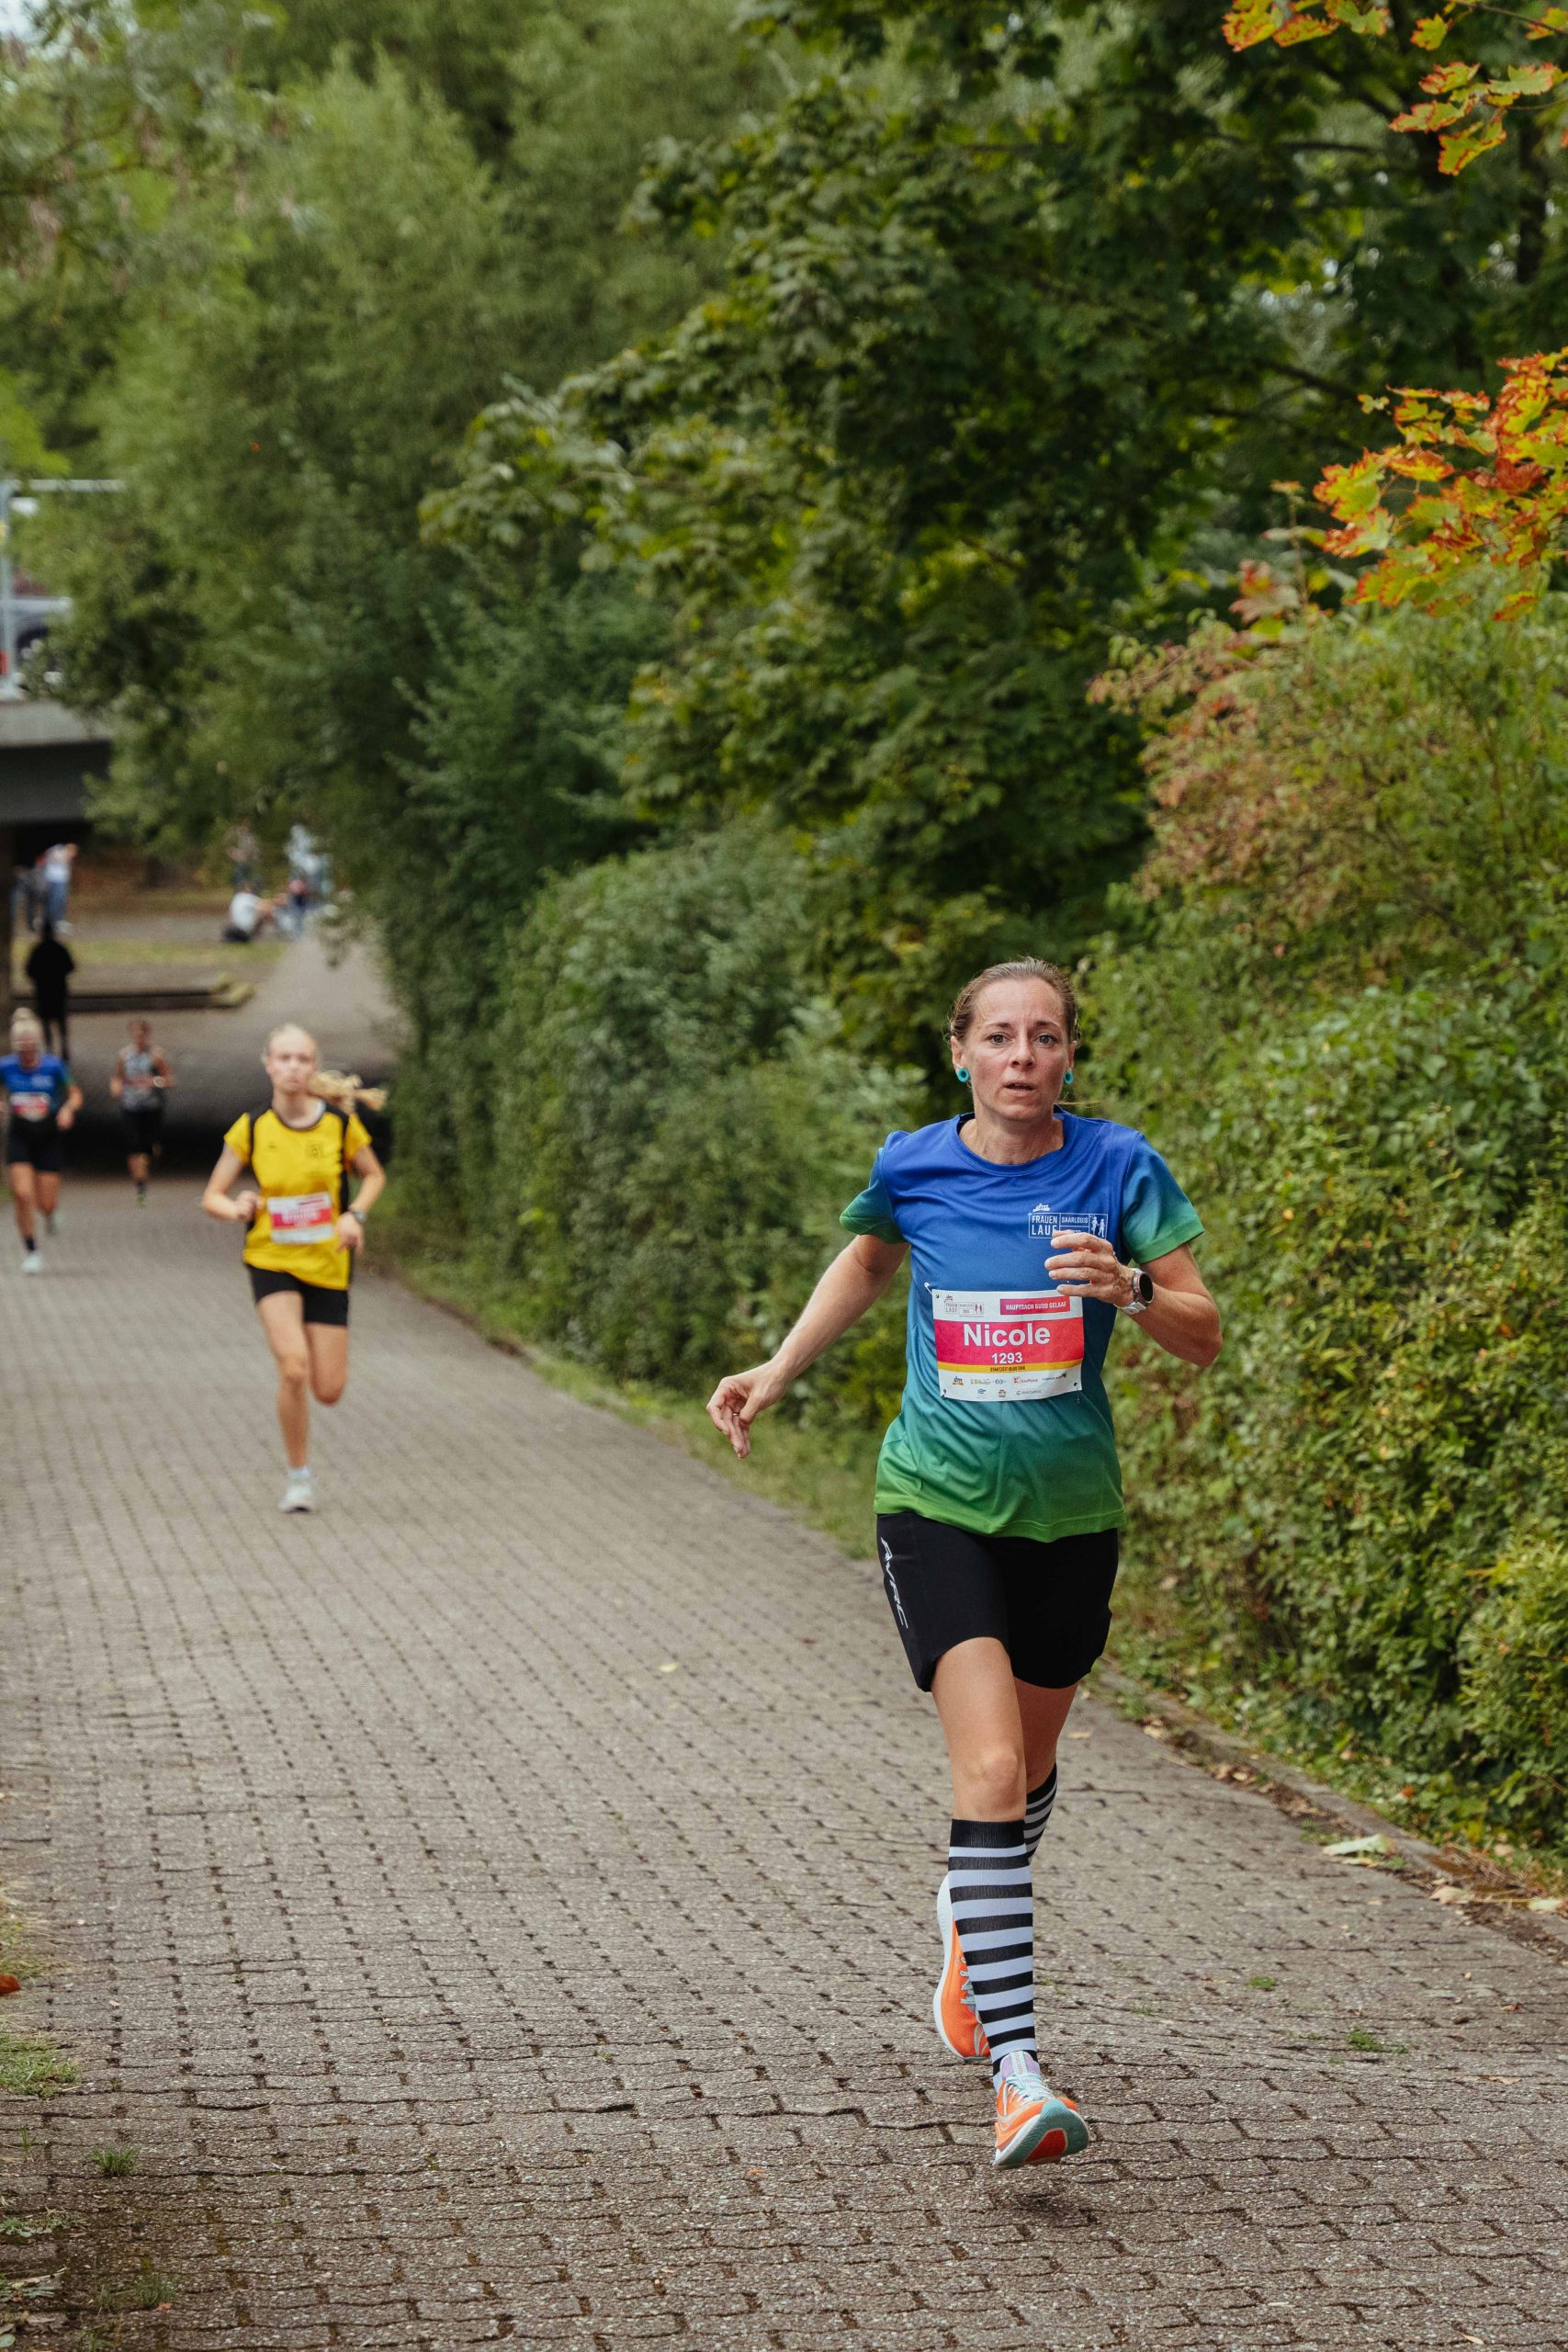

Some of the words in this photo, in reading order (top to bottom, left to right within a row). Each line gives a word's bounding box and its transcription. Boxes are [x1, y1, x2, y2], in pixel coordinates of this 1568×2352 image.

[1032, 1215, 1058, 1224] FRAUEN
[963, 1322, 1051, 1347] Nicole
[991, 1352, 1023, 1364] 1293
